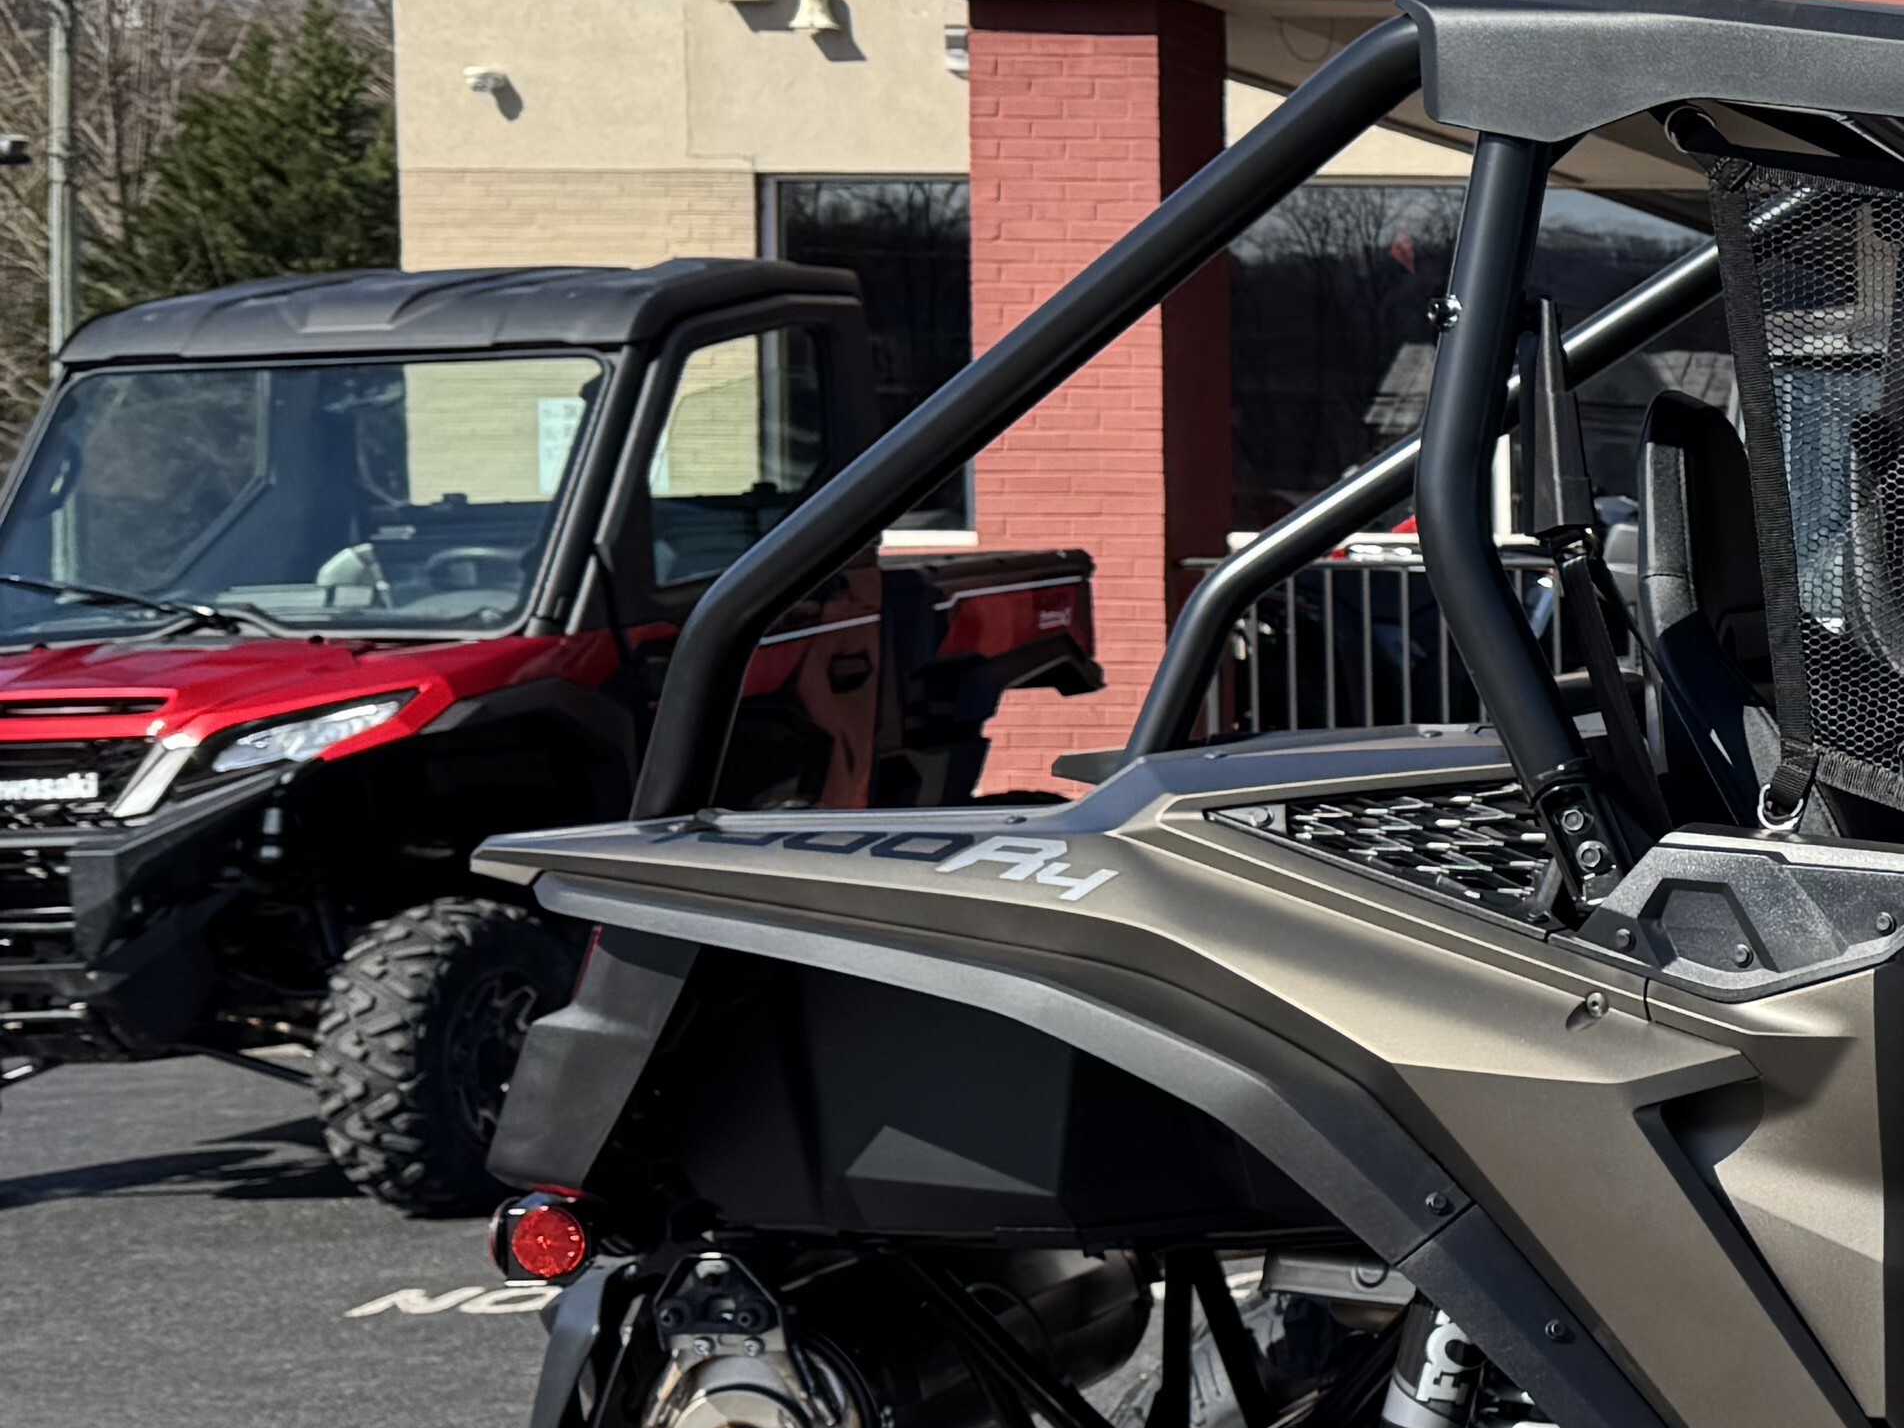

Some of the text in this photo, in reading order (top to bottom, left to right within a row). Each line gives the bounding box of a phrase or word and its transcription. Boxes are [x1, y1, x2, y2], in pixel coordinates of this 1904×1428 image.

[0, 772, 98, 800] wasaki
[345, 1286, 563, 1318] NO
[1416, 1309, 1484, 1405] FO
